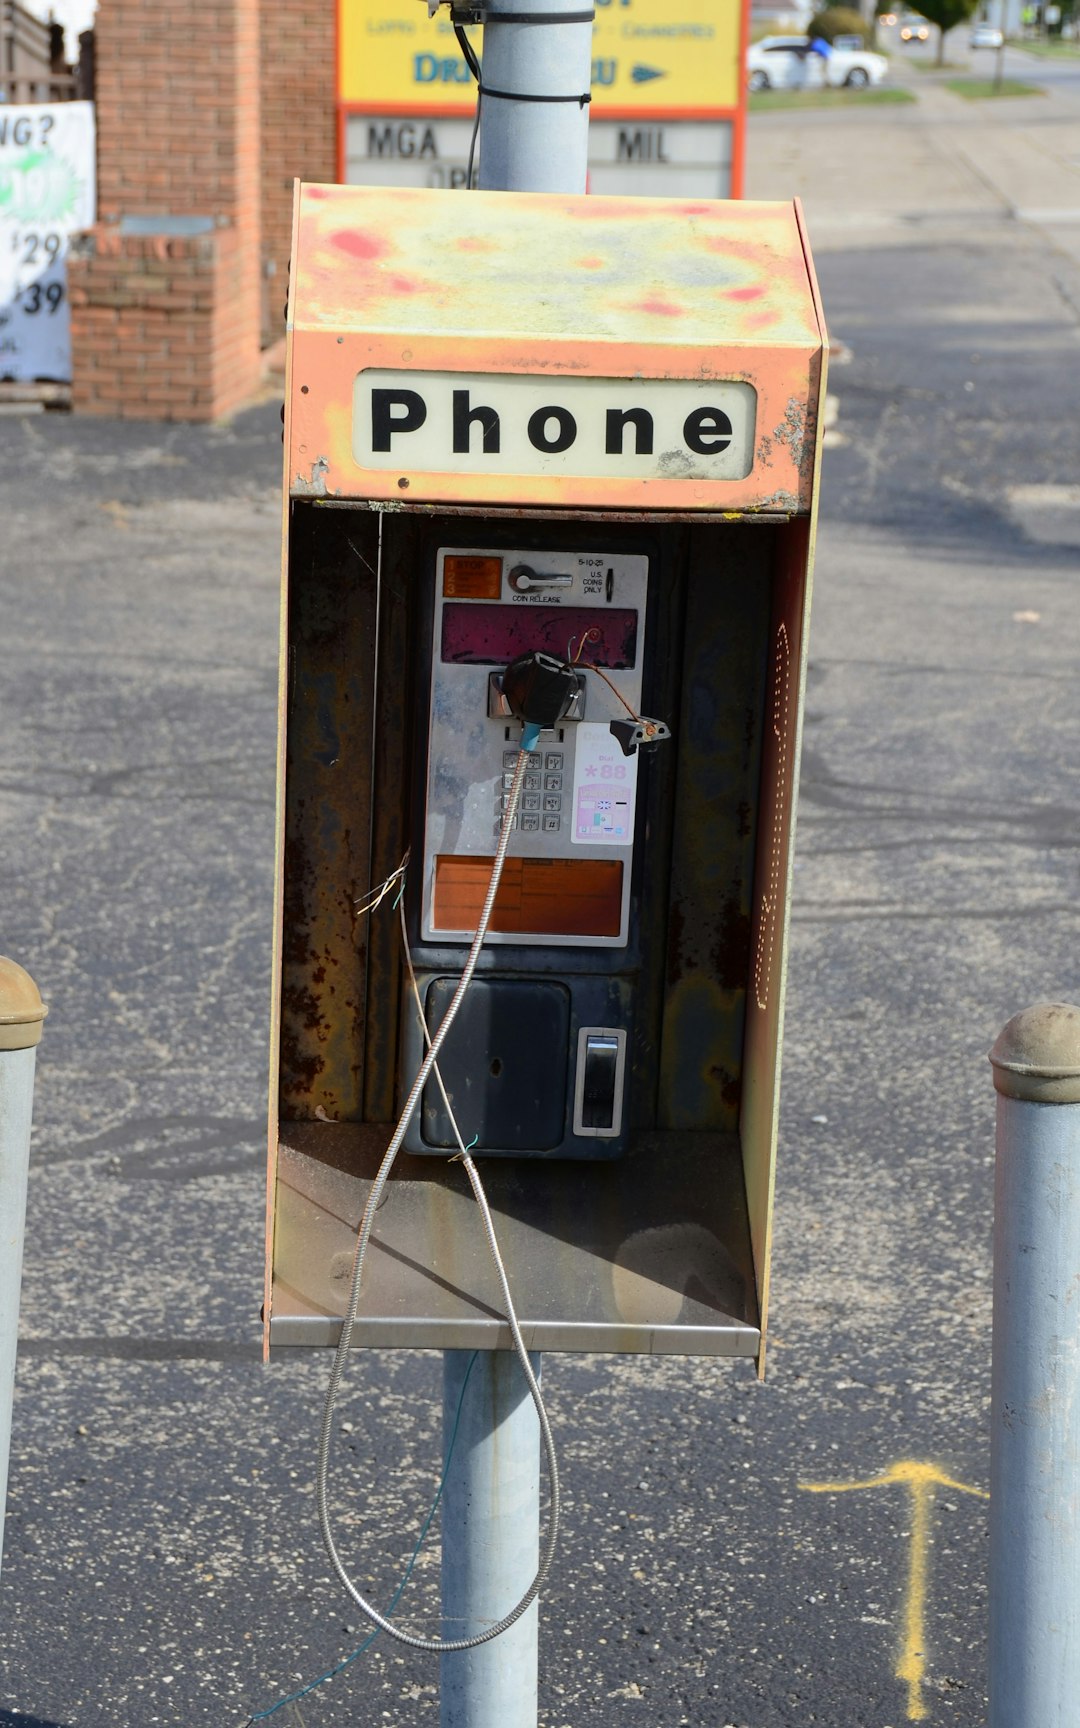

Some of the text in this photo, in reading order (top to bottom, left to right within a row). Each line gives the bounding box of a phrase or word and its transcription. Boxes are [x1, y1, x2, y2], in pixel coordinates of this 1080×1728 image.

[366, 123, 438, 160] MGA
[617, 126, 669, 163] MIL
[371, 388, 733, 456] Phone
[582, 578, 603, 586] COINS
[583, 586, 602, 594] ONLY
[512, 595, 561, 604] COIN RELEASE
